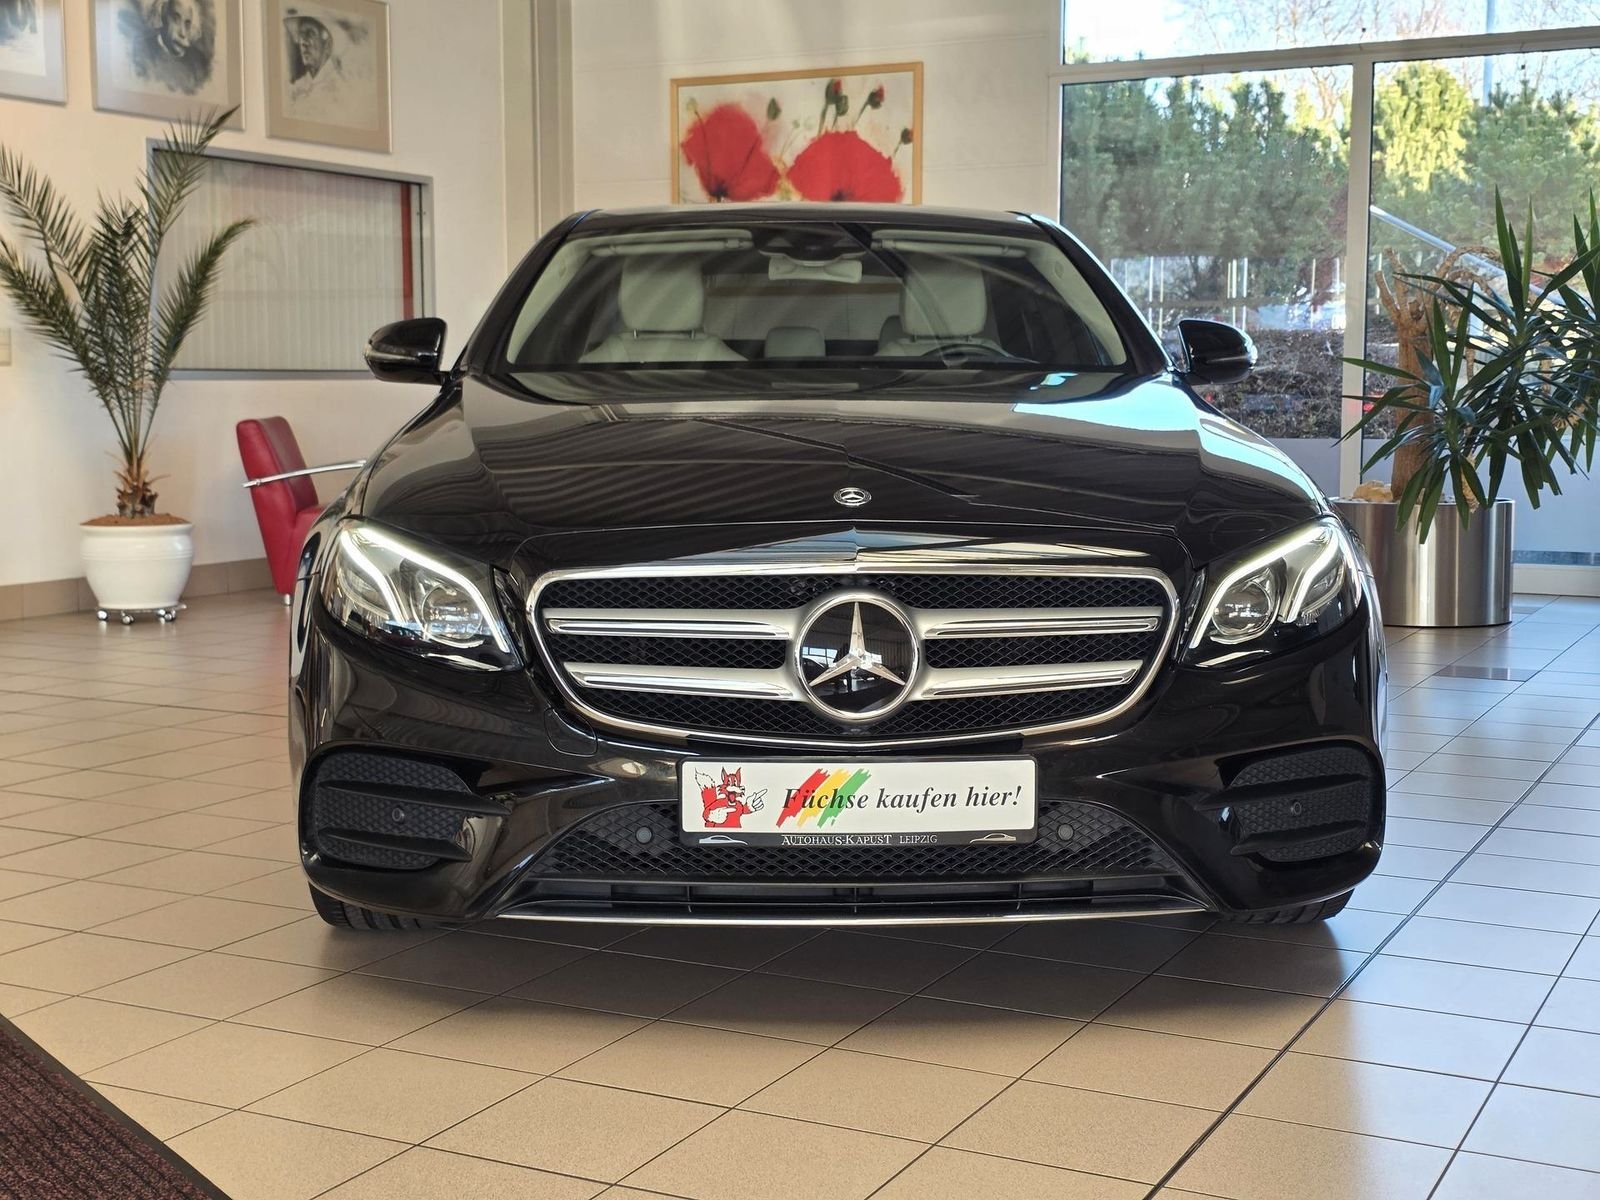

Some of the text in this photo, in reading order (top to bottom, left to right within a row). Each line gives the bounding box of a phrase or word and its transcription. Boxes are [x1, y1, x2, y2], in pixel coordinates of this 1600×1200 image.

[782, 785, 1023, 814] Füchse kaufen hier!
[899, 835, 938, 845] LEIPZIG
